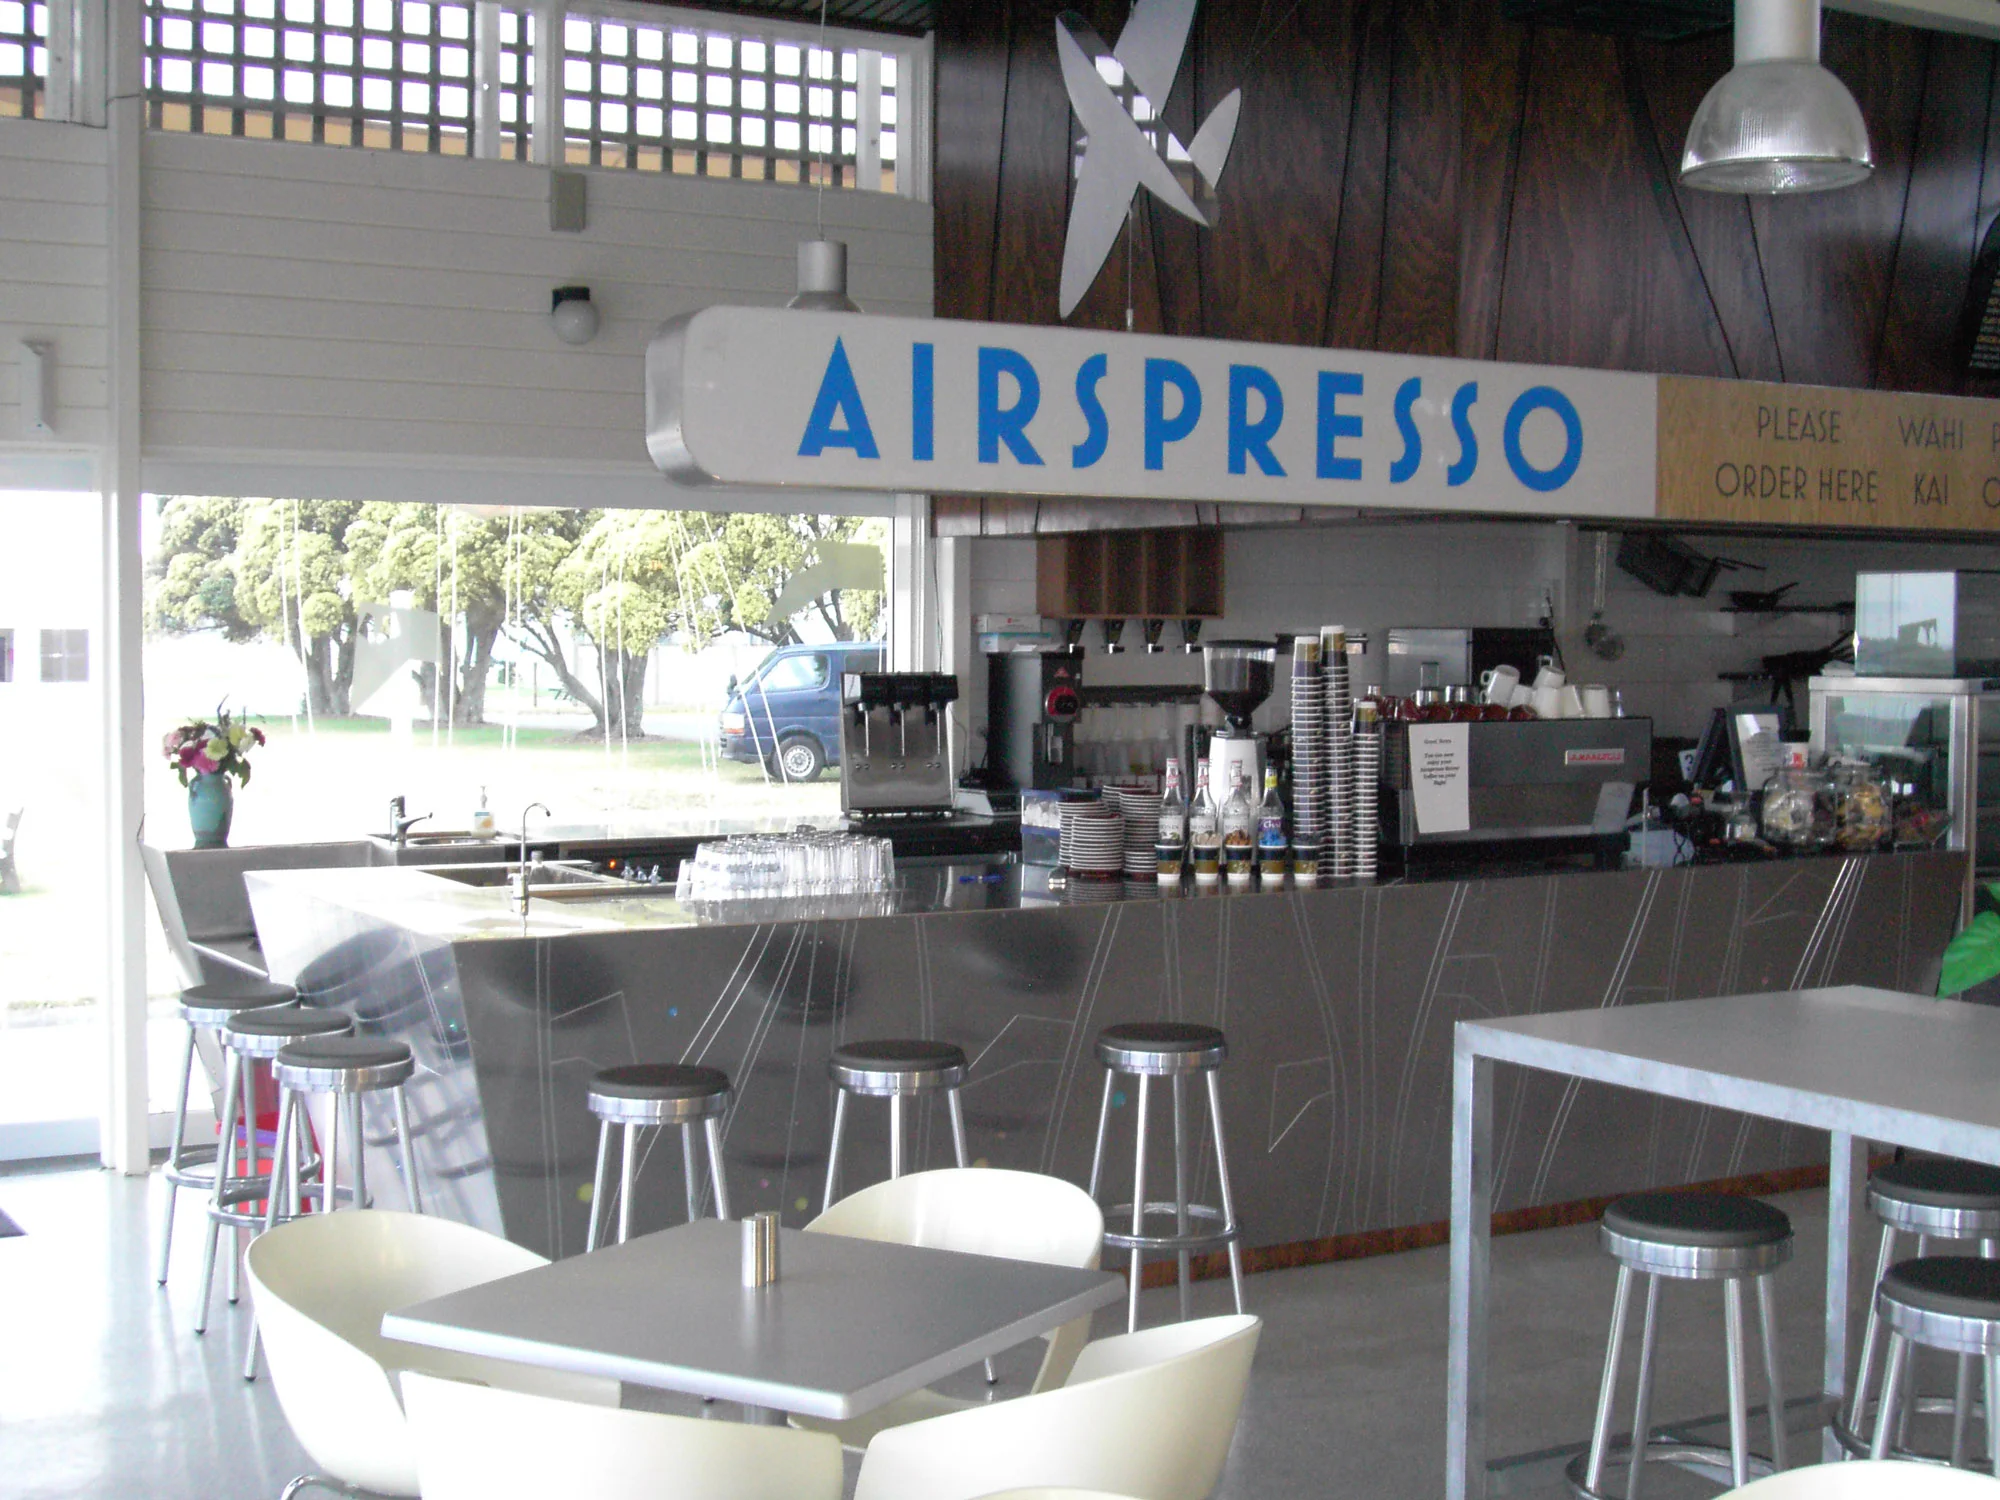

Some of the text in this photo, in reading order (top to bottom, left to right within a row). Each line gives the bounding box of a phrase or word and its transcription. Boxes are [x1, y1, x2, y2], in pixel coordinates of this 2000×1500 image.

[797, 338, 1583, 493] AIRSPRESSO
[1757, 405, 1841, 444] PLEASE
[1897, 415, 1963, 450] WAHI
[1715, 462, 1879, 503] ORDER HERE
[1914, 472, 1948, 505] KAI
